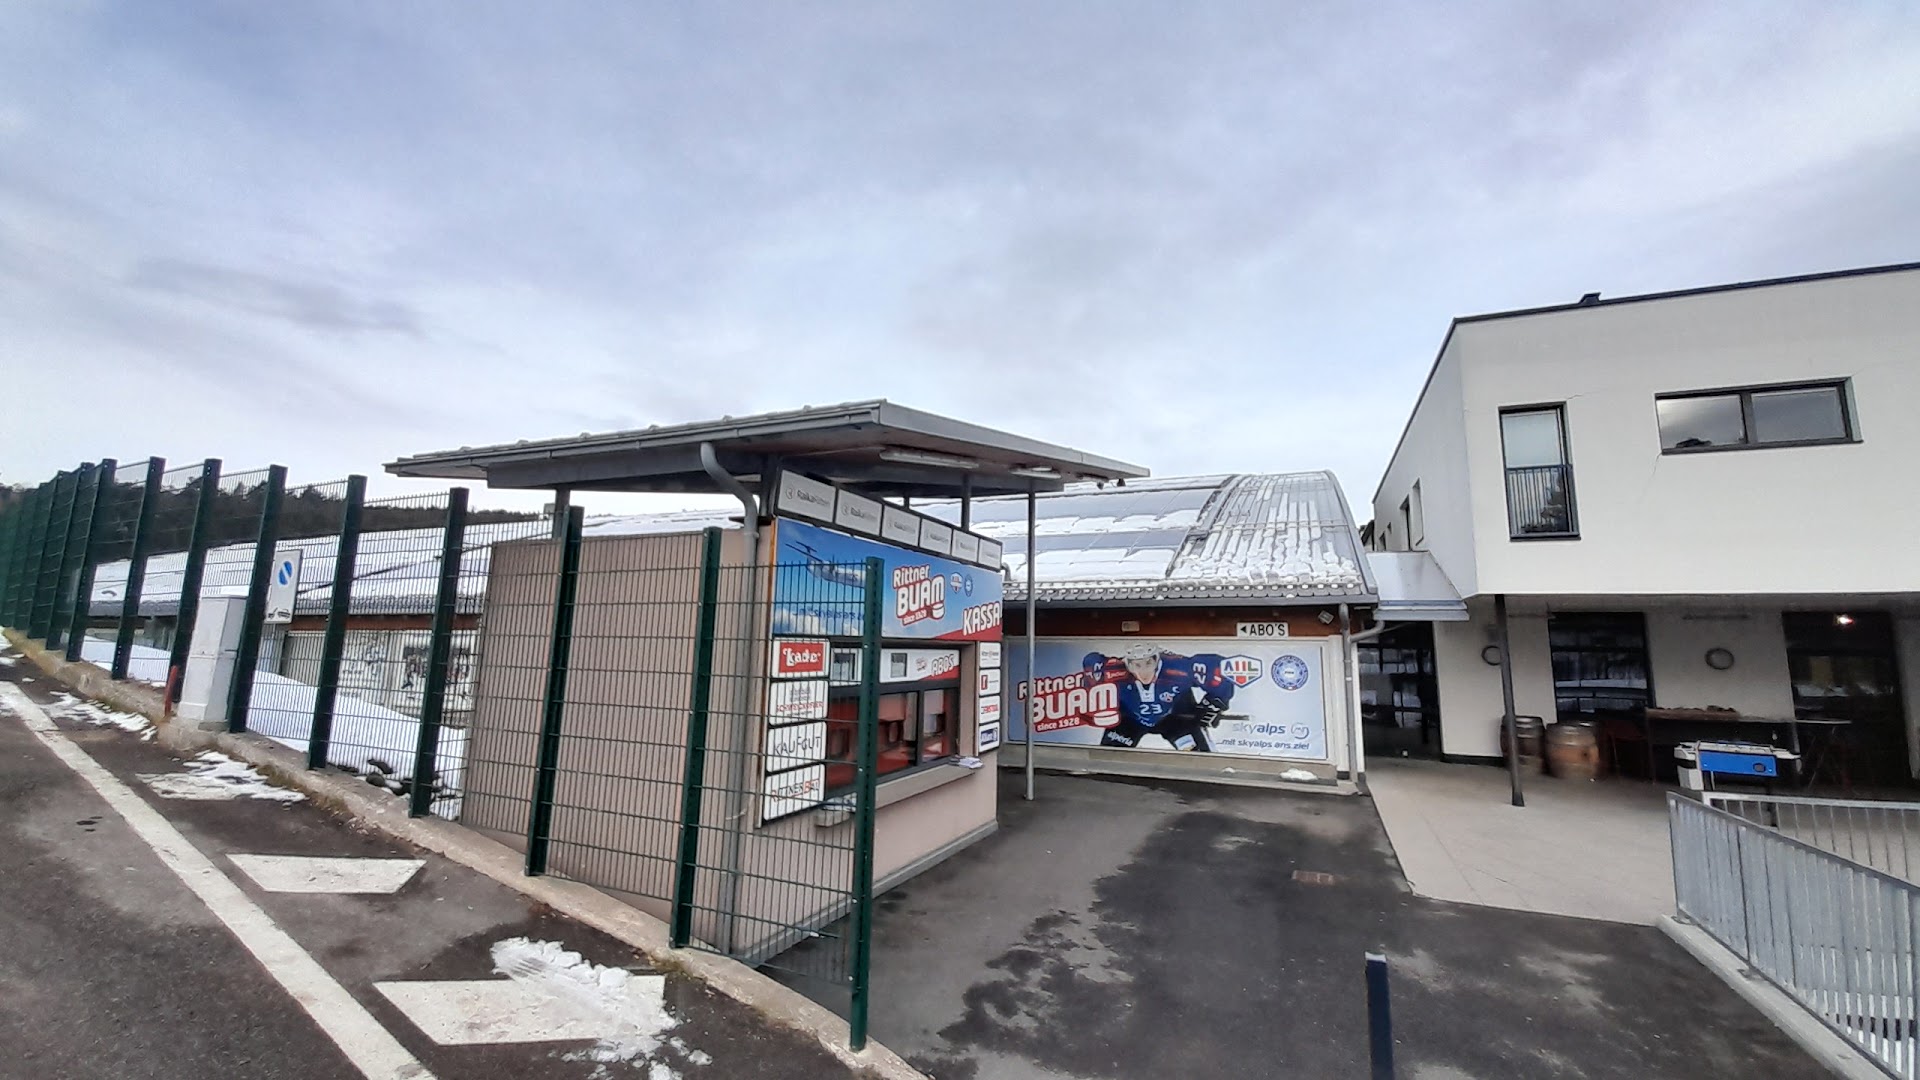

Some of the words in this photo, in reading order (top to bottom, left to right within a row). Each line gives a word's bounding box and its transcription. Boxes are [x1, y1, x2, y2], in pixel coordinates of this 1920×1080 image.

[893, 565, 930, 588] Rittner
[897, 575, 945, 617] BUAM
[963, 601, 1000, 636] KASSA
[1249, 624, 1285, 636] ABO'S
[931, 654, 954, 677] ABOS
[1018, 673, 1083, 699] Rittner
[1032, 682, 1118, 723] BUAM
[1139, 703, 1163, 715] 23
[1037, 722, 1057, 731] since
[1058, 717, 1080, 728] 1928
[1232, 722, 1287, 736] skyalps
[1237, 739, 1273, 748] skyalps
